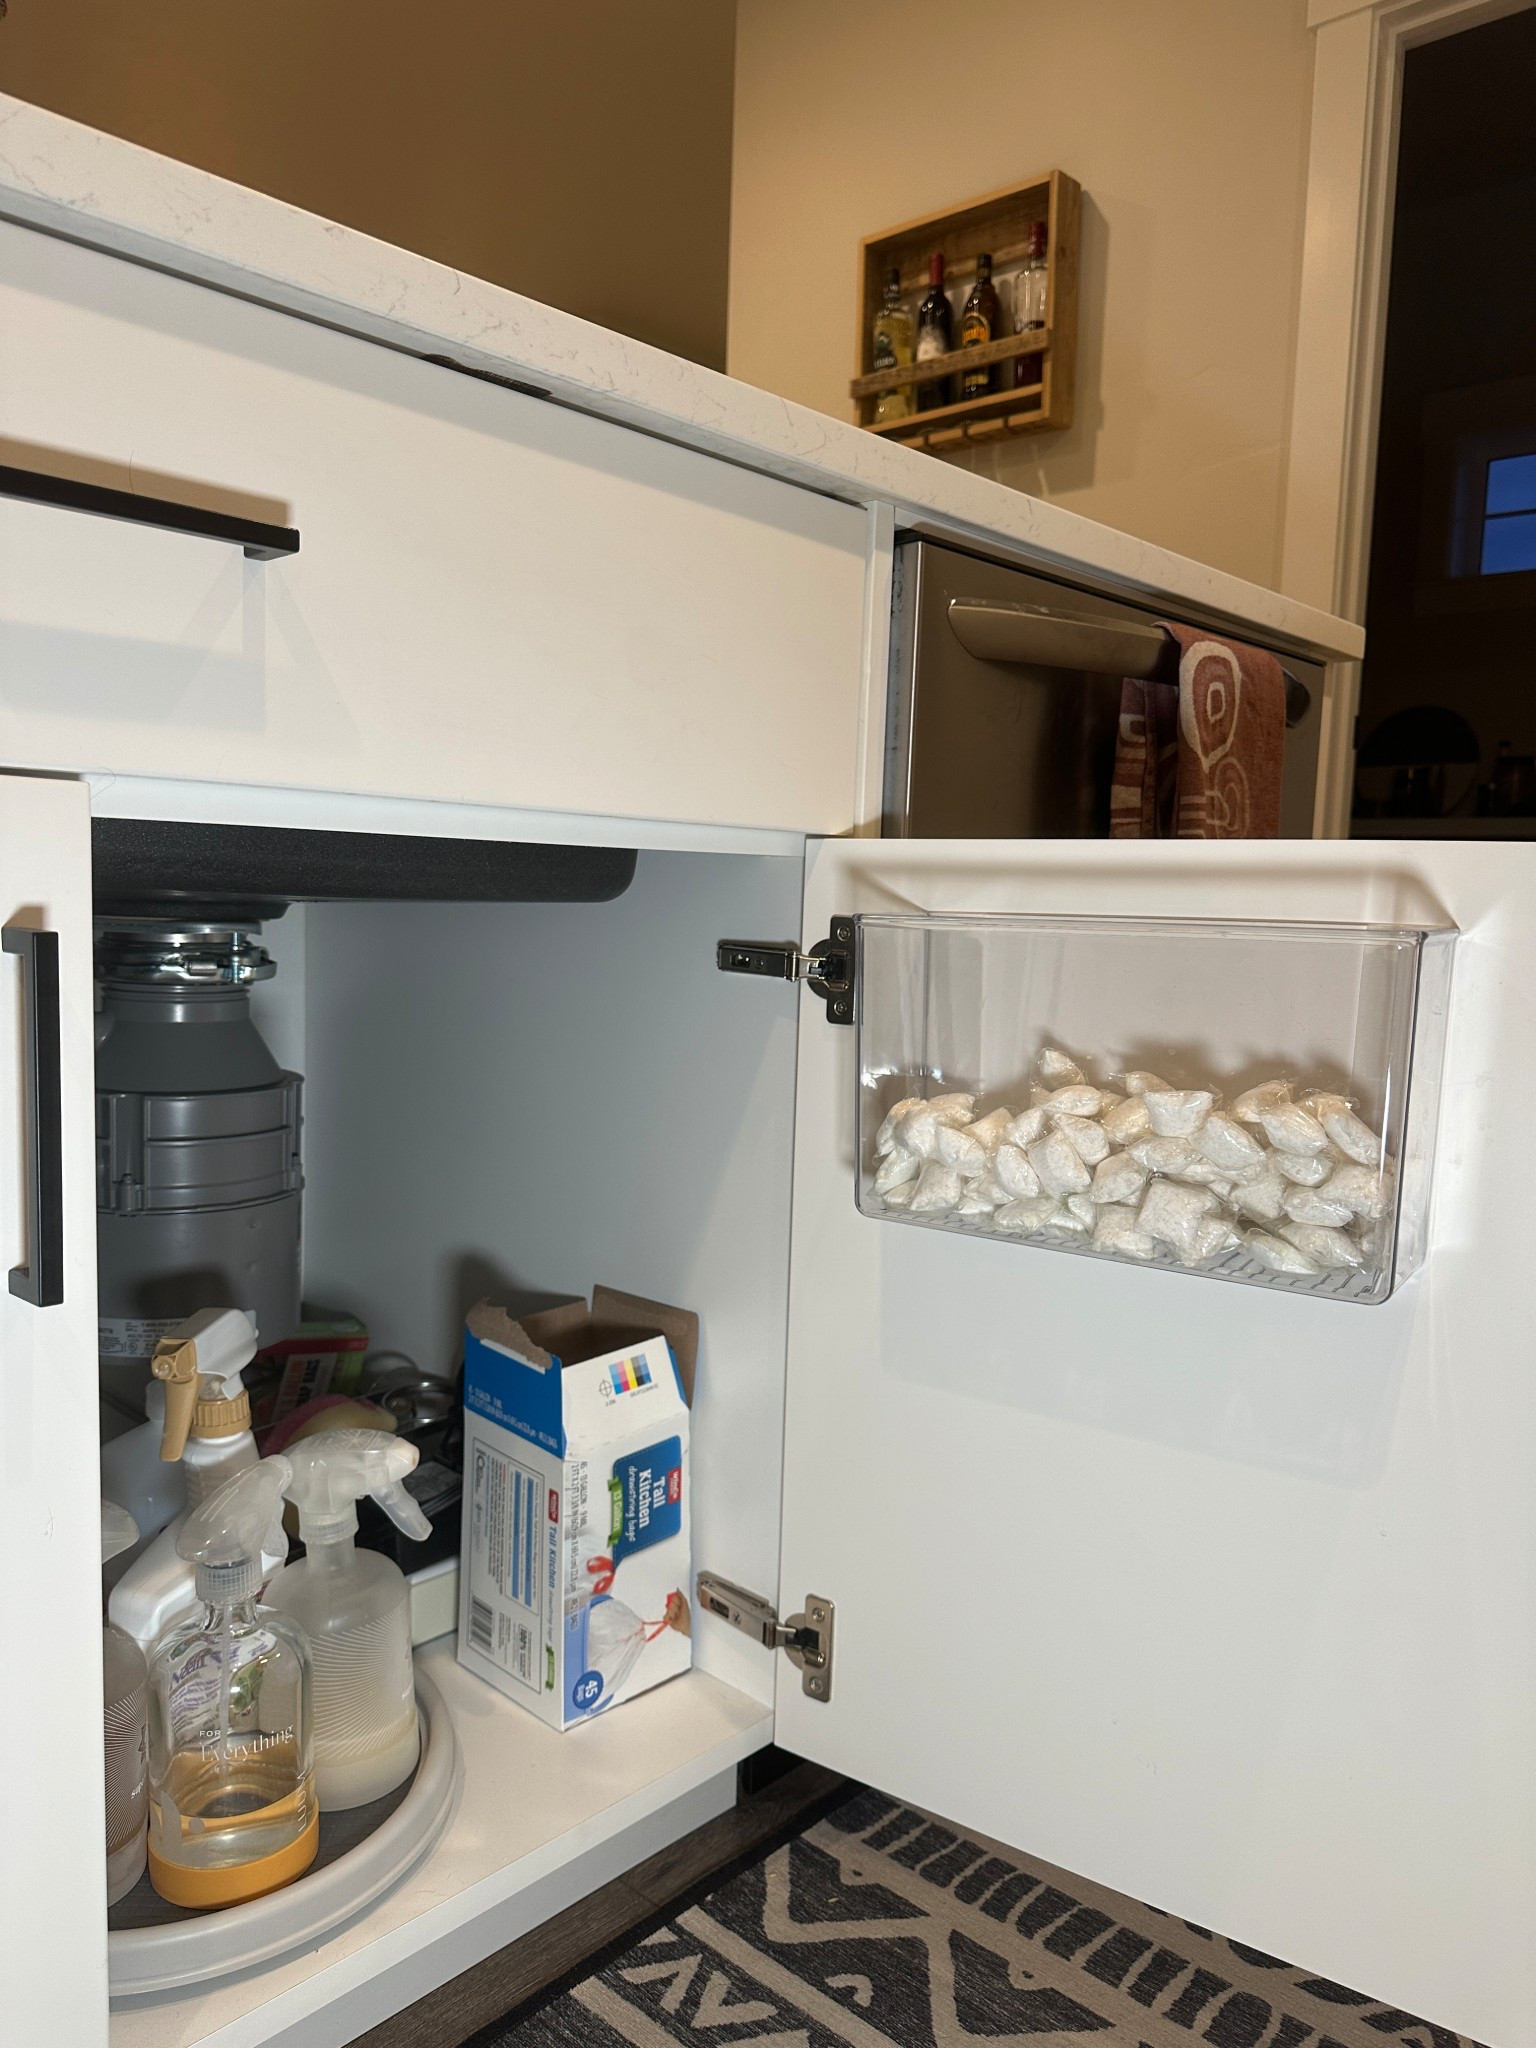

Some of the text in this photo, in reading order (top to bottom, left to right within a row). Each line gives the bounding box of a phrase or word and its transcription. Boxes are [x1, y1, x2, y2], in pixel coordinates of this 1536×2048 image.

[624, 1465, 639, 1542] drawstring bags
[638, 1468, 652, 1529] Kitchen
[653, 1475, 666, 1509] Tall
[549, 1526, 558, 1546] Tall
[548, 1548, 557, 1588] Kitchen
[585, 1680, 599, 1699] 45
[199, 1730, 222, 1738] FOR
[201, 1725, 295, 1763] Everything
